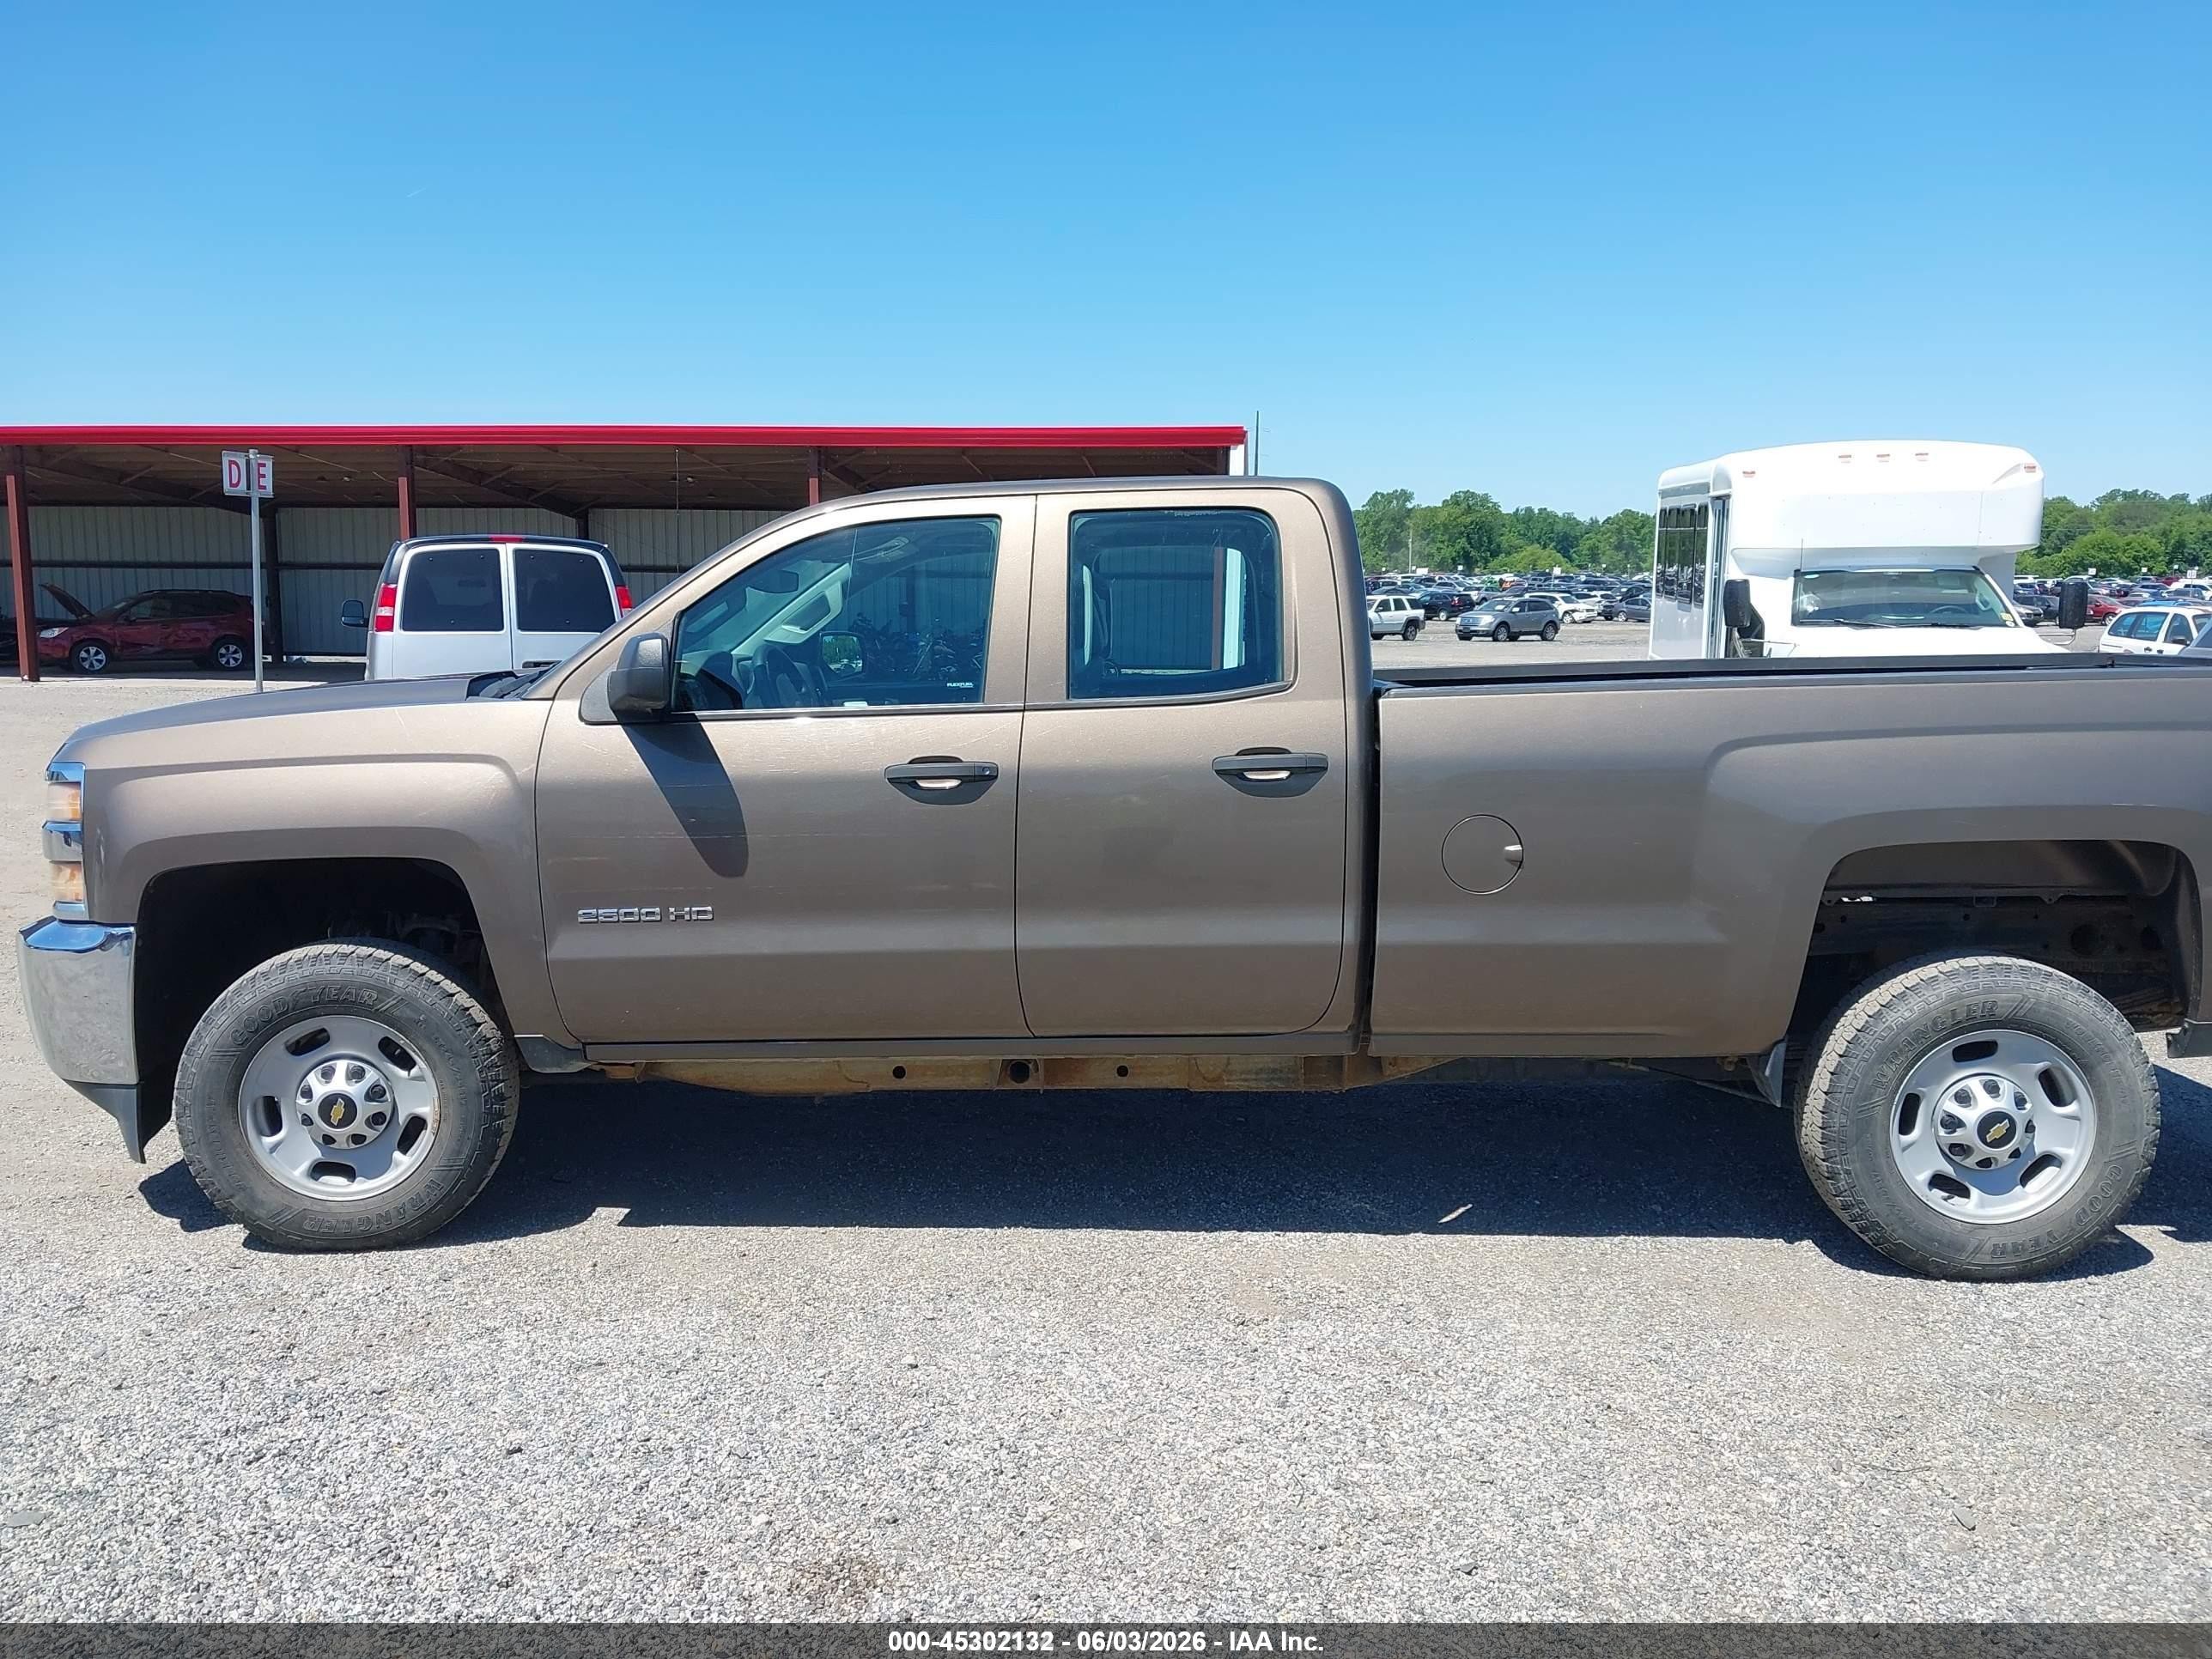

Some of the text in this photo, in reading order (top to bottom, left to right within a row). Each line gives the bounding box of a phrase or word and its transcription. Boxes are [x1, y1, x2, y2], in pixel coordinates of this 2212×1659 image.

[228, 459, 267, 490] D E
[577, 906, 714, 923] 2500 HD
[1869, 998, 2001, 1091] WRANGLER
[302, 1177, 445, 1234] WRANGLER
